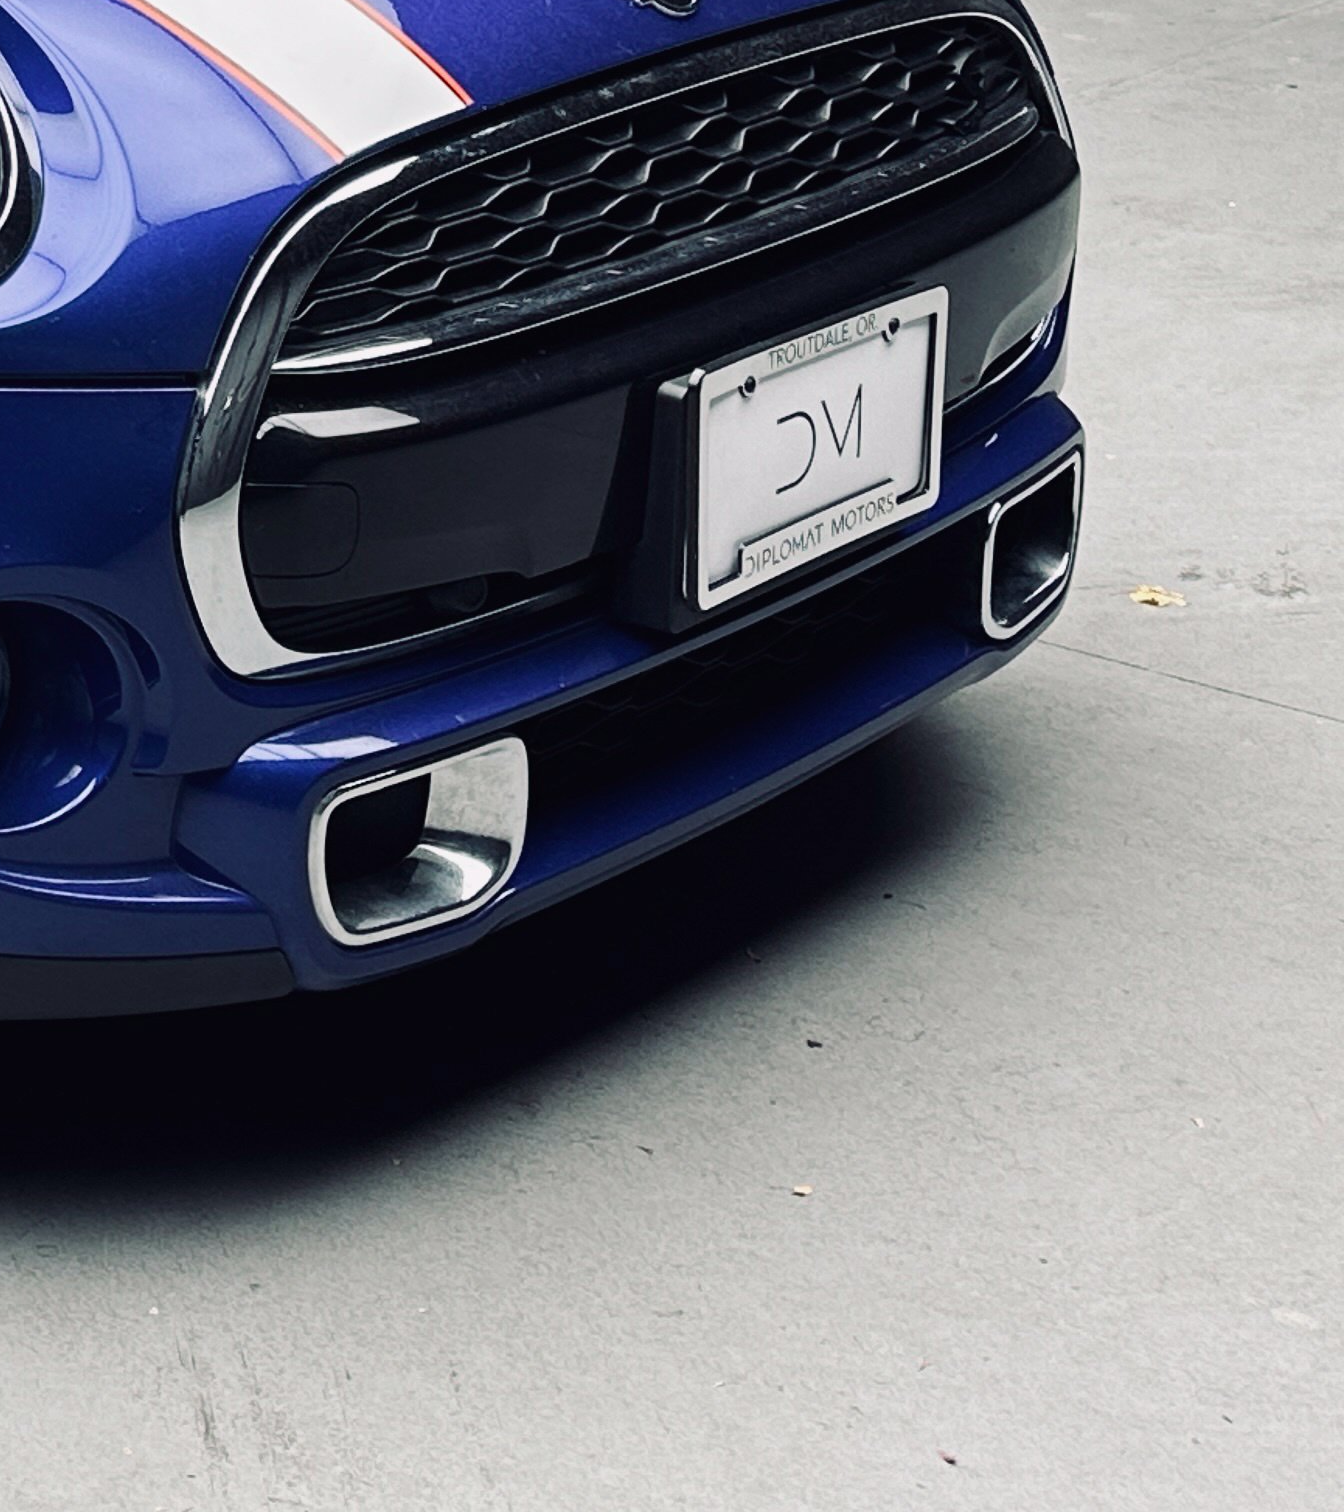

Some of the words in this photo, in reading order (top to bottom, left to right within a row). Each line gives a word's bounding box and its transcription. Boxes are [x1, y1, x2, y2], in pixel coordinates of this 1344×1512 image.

[768, 325, 853, 369] TROUTDALE,
[744, 522, 824, 577] DIPLOMAT
[830, 491, 895, 538] MOTORS
